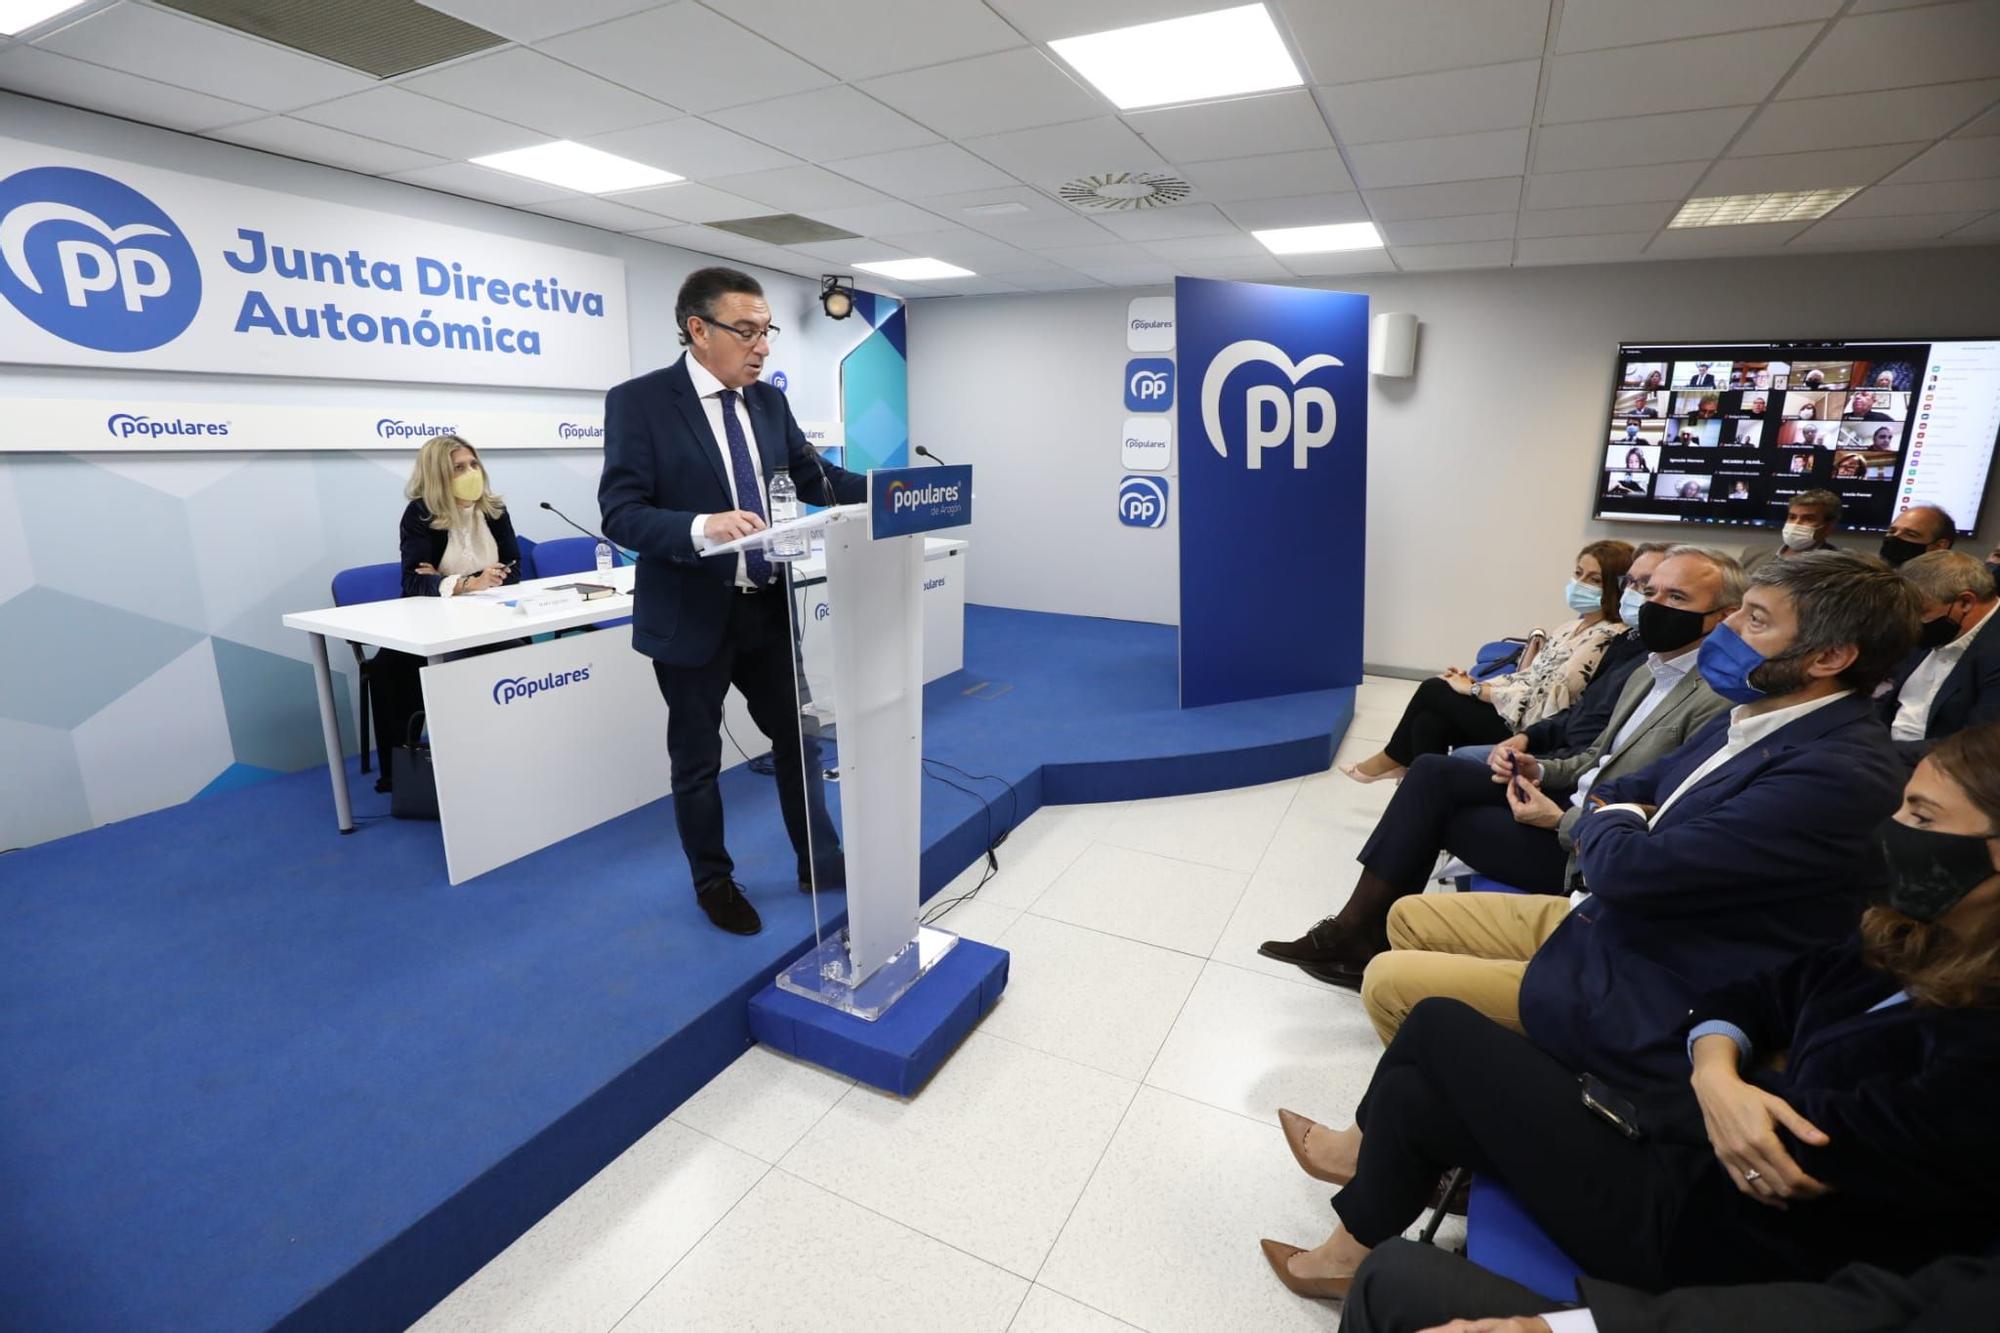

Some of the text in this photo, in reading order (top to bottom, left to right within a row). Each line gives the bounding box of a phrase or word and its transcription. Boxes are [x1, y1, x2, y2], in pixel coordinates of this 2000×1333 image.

[223, 228, 605, 318] Junta Directiva
[234, 291, 541, 356] Autonómica
[1134, 320, 1173, 331] populares
[120, 418, 229, 439] populares
[385, 422, 458, 439] populares
[1129, 439, 1166, 449] populares
[894, 483, 960, 515] populares
[503, 667, 590, 704] populares
